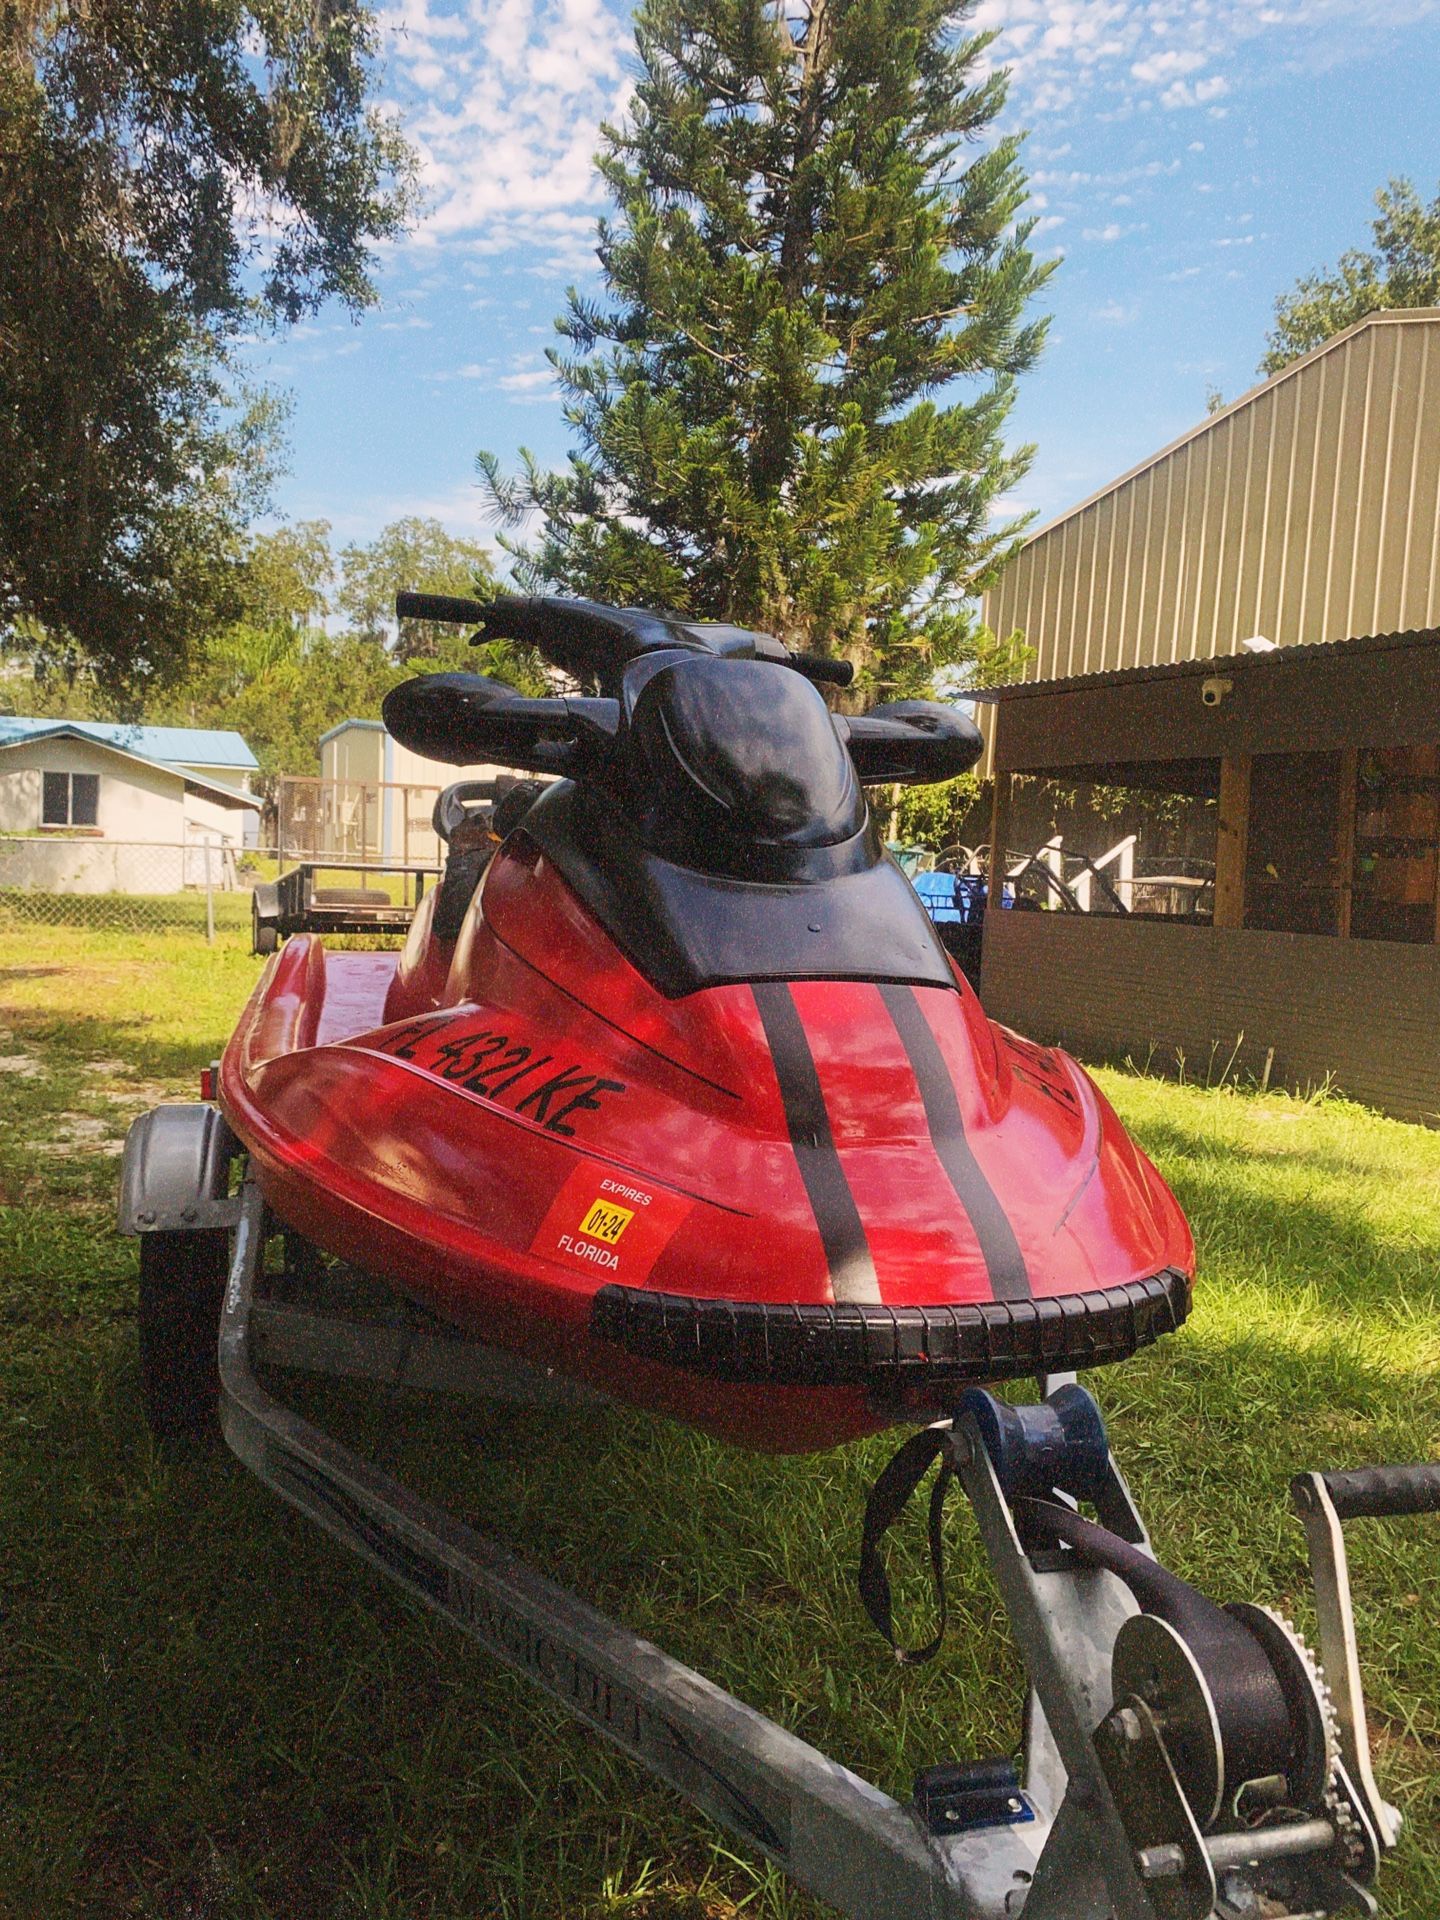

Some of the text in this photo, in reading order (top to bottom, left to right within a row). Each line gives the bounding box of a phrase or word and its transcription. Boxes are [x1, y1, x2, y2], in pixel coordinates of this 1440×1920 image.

[430, 1031, 554, 1100] 4321
[515, 1065, 626, 1137] KE
[599, 1178, 653, 1206] EXPIRES
[586, 1208, 626, 1241] 01-24
[556, 1234, 620, 1271] FLORIDA
